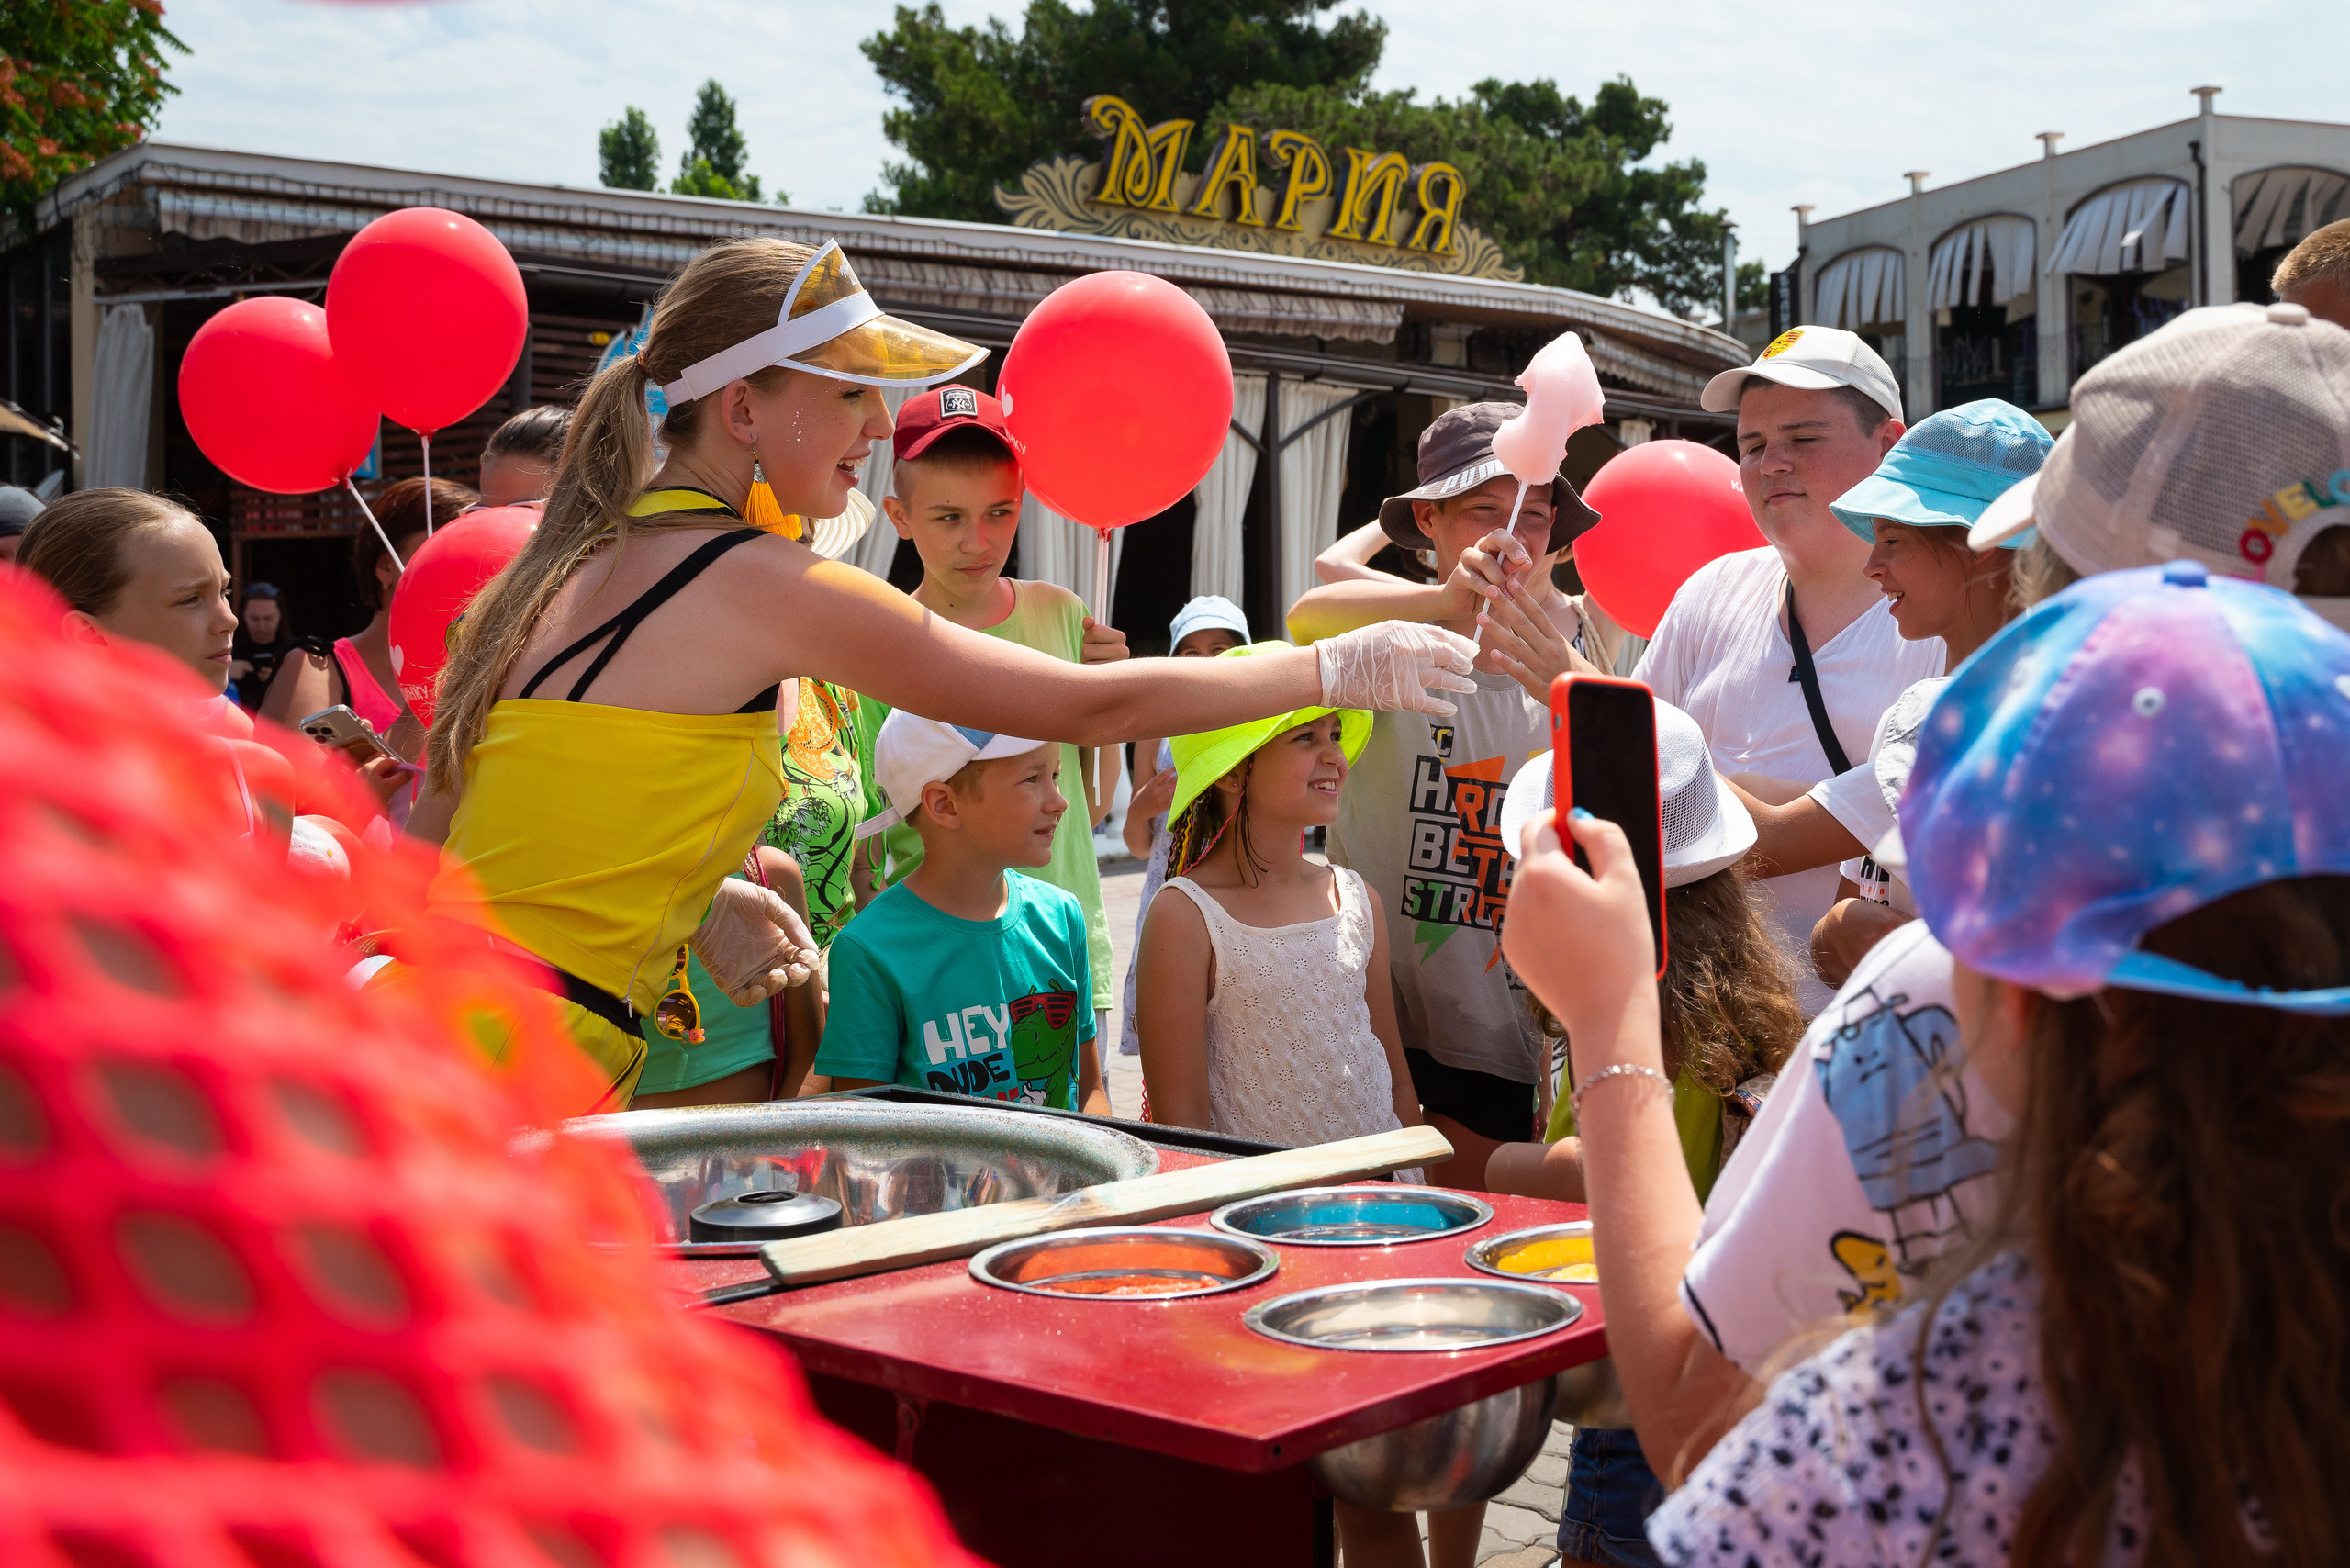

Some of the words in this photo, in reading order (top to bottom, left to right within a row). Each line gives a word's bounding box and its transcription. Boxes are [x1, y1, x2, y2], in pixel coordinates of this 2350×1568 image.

[1083, 95, 1466, 255] МАРИЯ
[1439, 459, 1505, 494] PUM
[923, 1002, 1010, 1065] HEY
[926, 1052, 1011, 1095] DUDE
